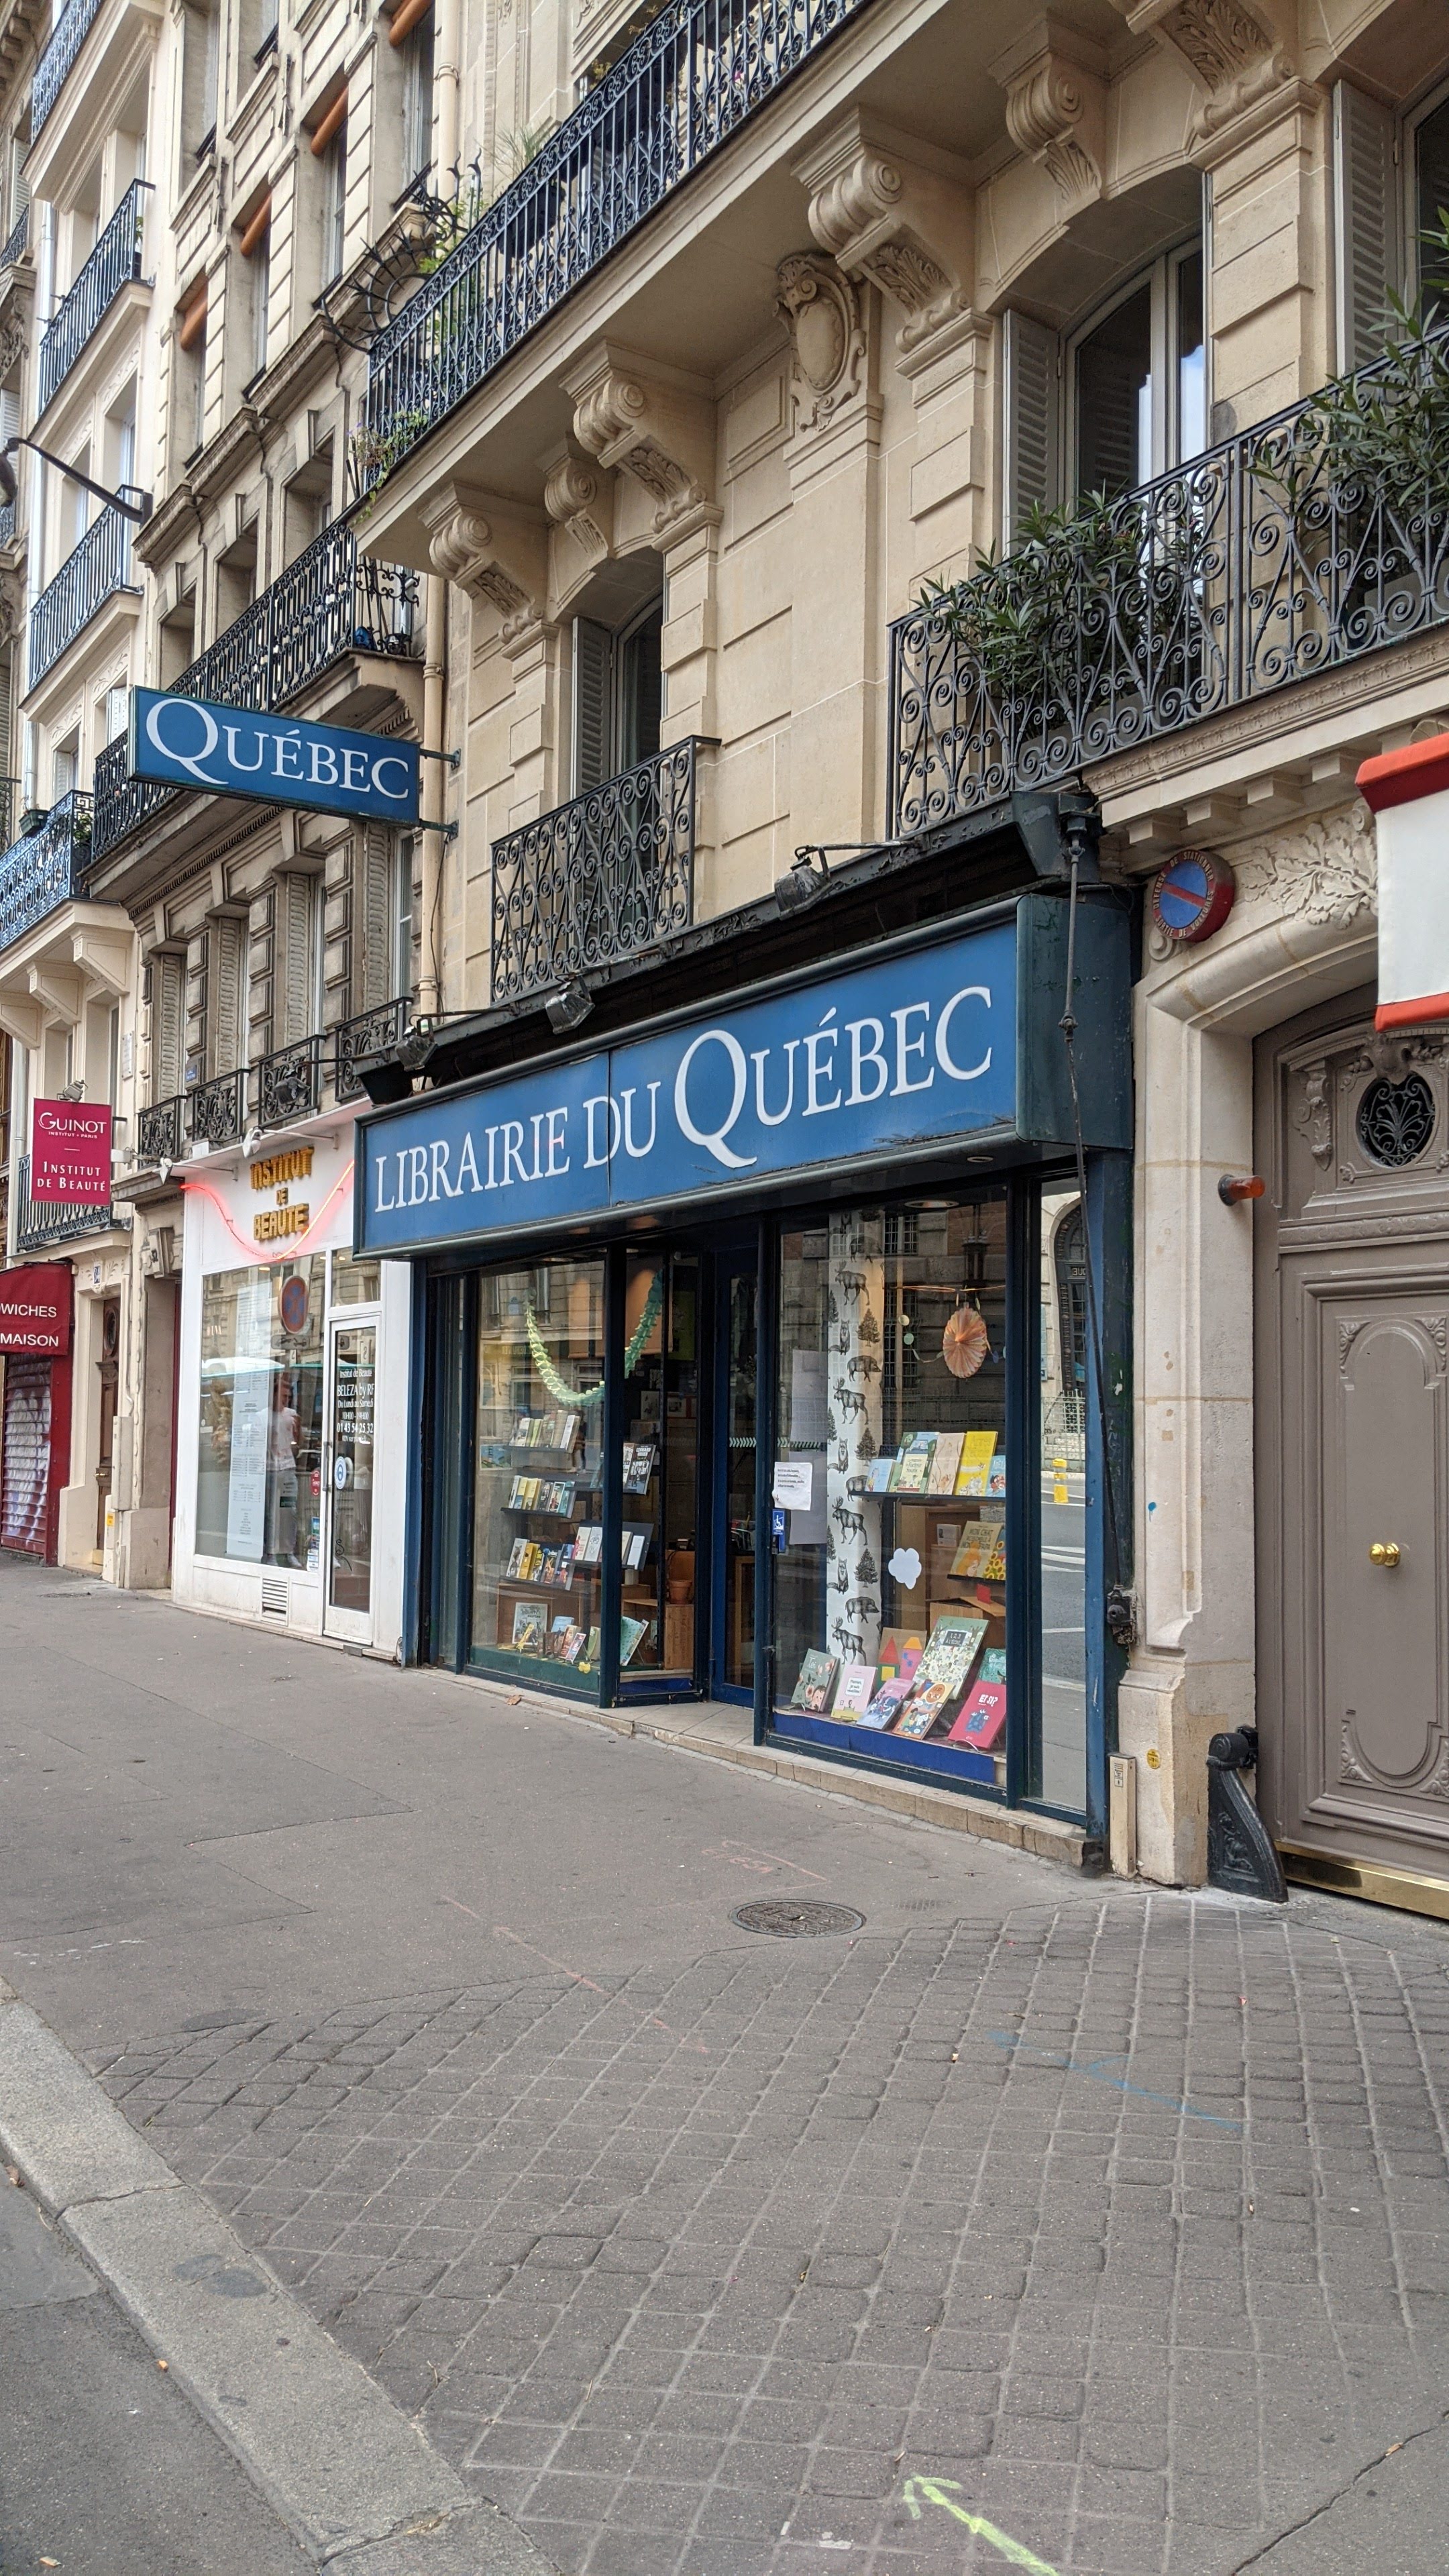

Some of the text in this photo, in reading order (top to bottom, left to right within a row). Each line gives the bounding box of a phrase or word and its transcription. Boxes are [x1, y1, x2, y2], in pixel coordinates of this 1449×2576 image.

[146, 698, 409, 799] QUÉBEC
[1153, 851, 1214, 910] DEFENSE DE STATIONNER
[1155, 891, 1214, 938] SORTIE DE VOITURES
[374, 985, 993, 1214] LIBRAIRIE DU QUÉBEC
[38, 1112, 107, 1134] GUINOT
[43, 1161, 101, 1177] INSTITUT
[250, 1146, 315, 1190] INSTITUT
[37, 1177, 106, 1191] DE BEAUTÉ
[276, 1187, 288, 1205] DE
[254, 1203, 310, 1241] BEAUTE
[0, 1303, 57, 1318] WICHES
[0, 1333, 59, 1347] MAISON
[337, 1383, 375, 1399] BELEZA by RF
[337, 1423, 374, 1434] 01 43 54 25 32
